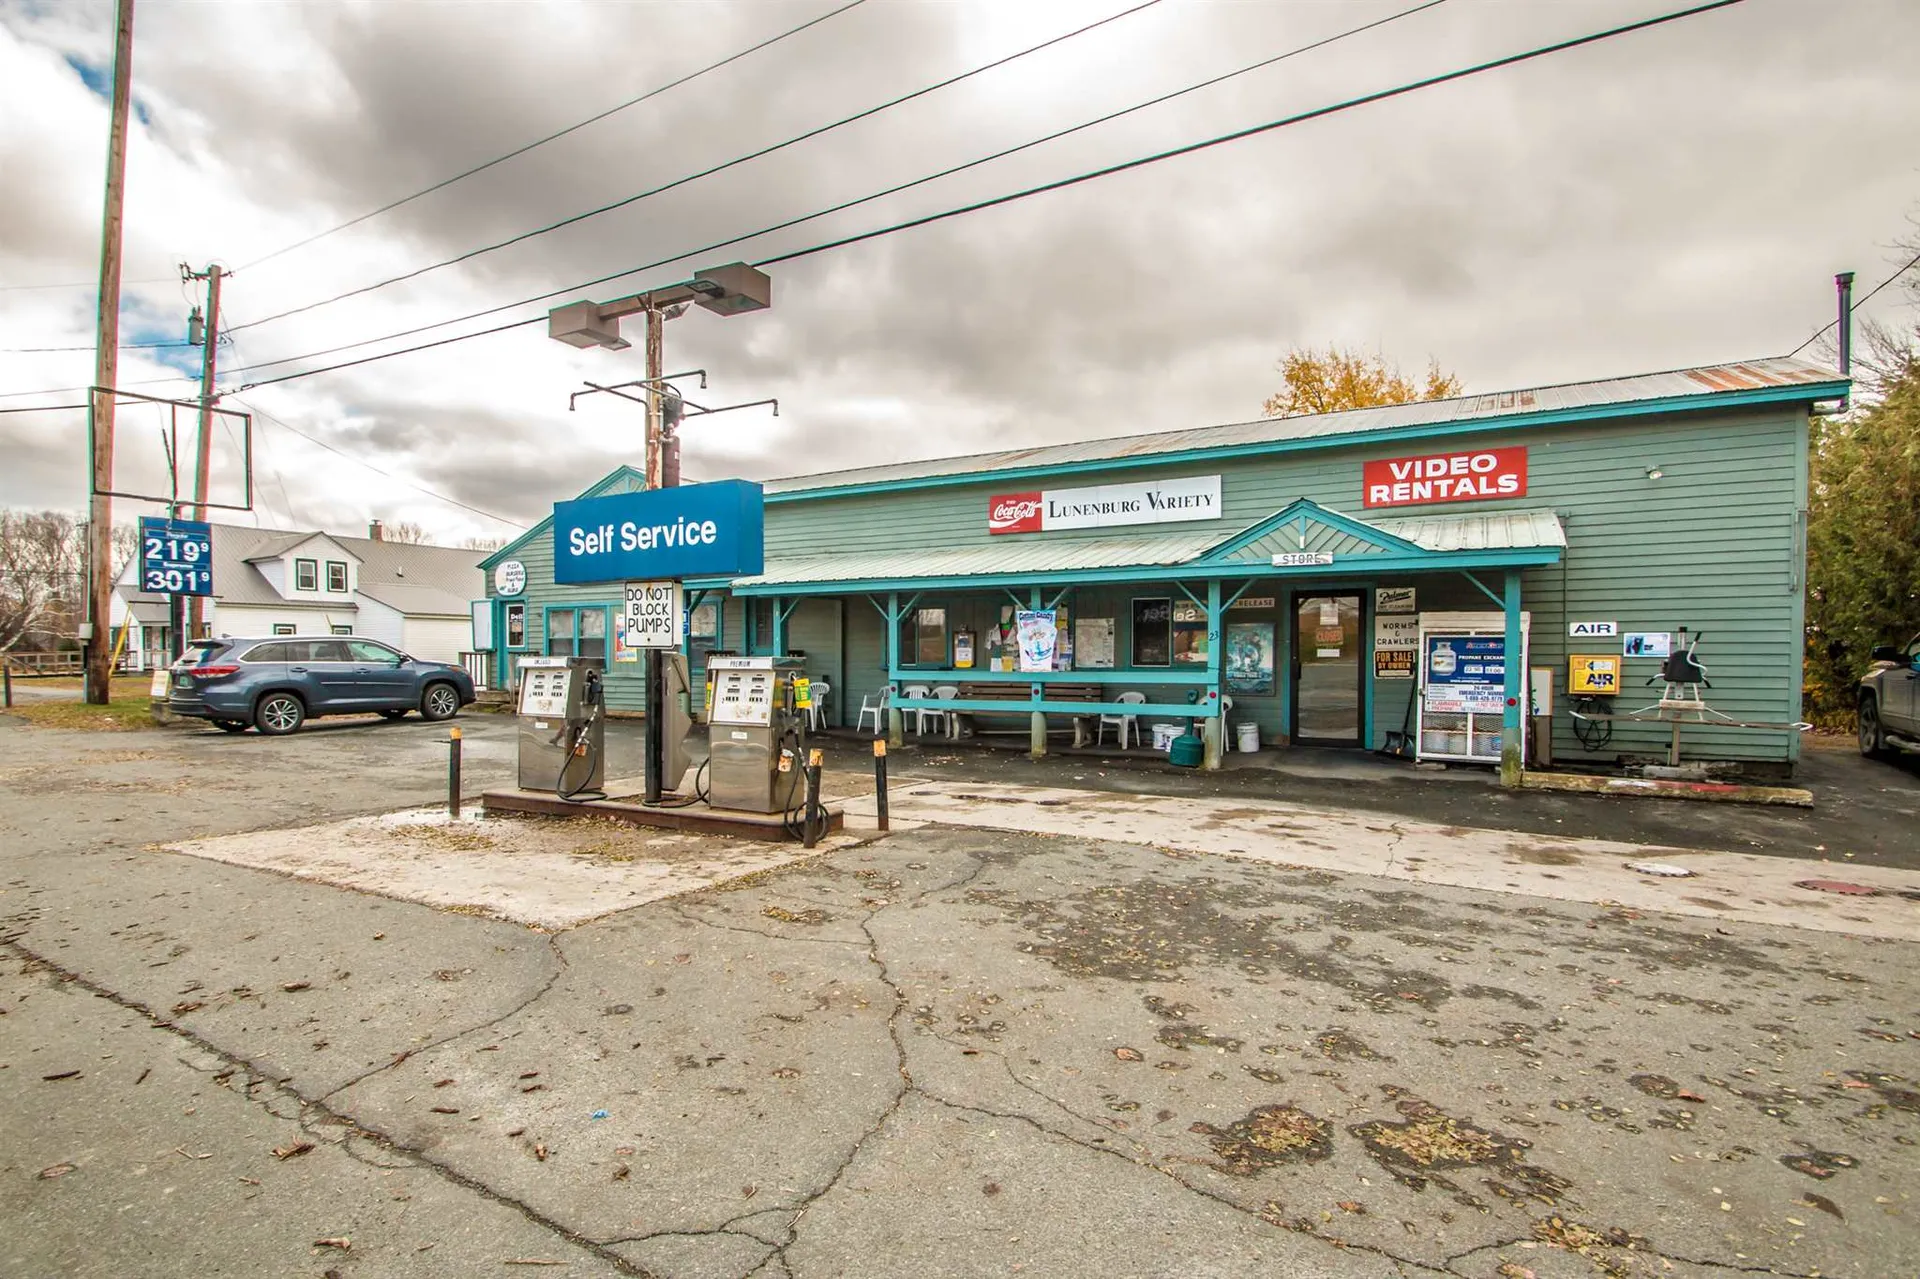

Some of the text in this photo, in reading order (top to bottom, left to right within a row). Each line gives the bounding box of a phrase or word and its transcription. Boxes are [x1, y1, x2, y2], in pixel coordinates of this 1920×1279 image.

[1389, 454, 1498, 480] VIDEO
[1369, 474, 1519, 503] RENTALS
[570, 516, 717, 556] Self Service
[1282, 554, 1321, 565] STORE
[627, 588, 672, 601] DO NOT
[633, 603, 669, 616] BLOCK
[628, 618, 671, 633] PUMPS
[1383, 622, 1414, 630] WORMS
[1574, 624, 1611, 633] AIR
[1377, 638, 1420, 646] CRAWLERS
[1376, 651, 1412, 662] FOR SALE
[1586, 673, 1614, 685] AIR
